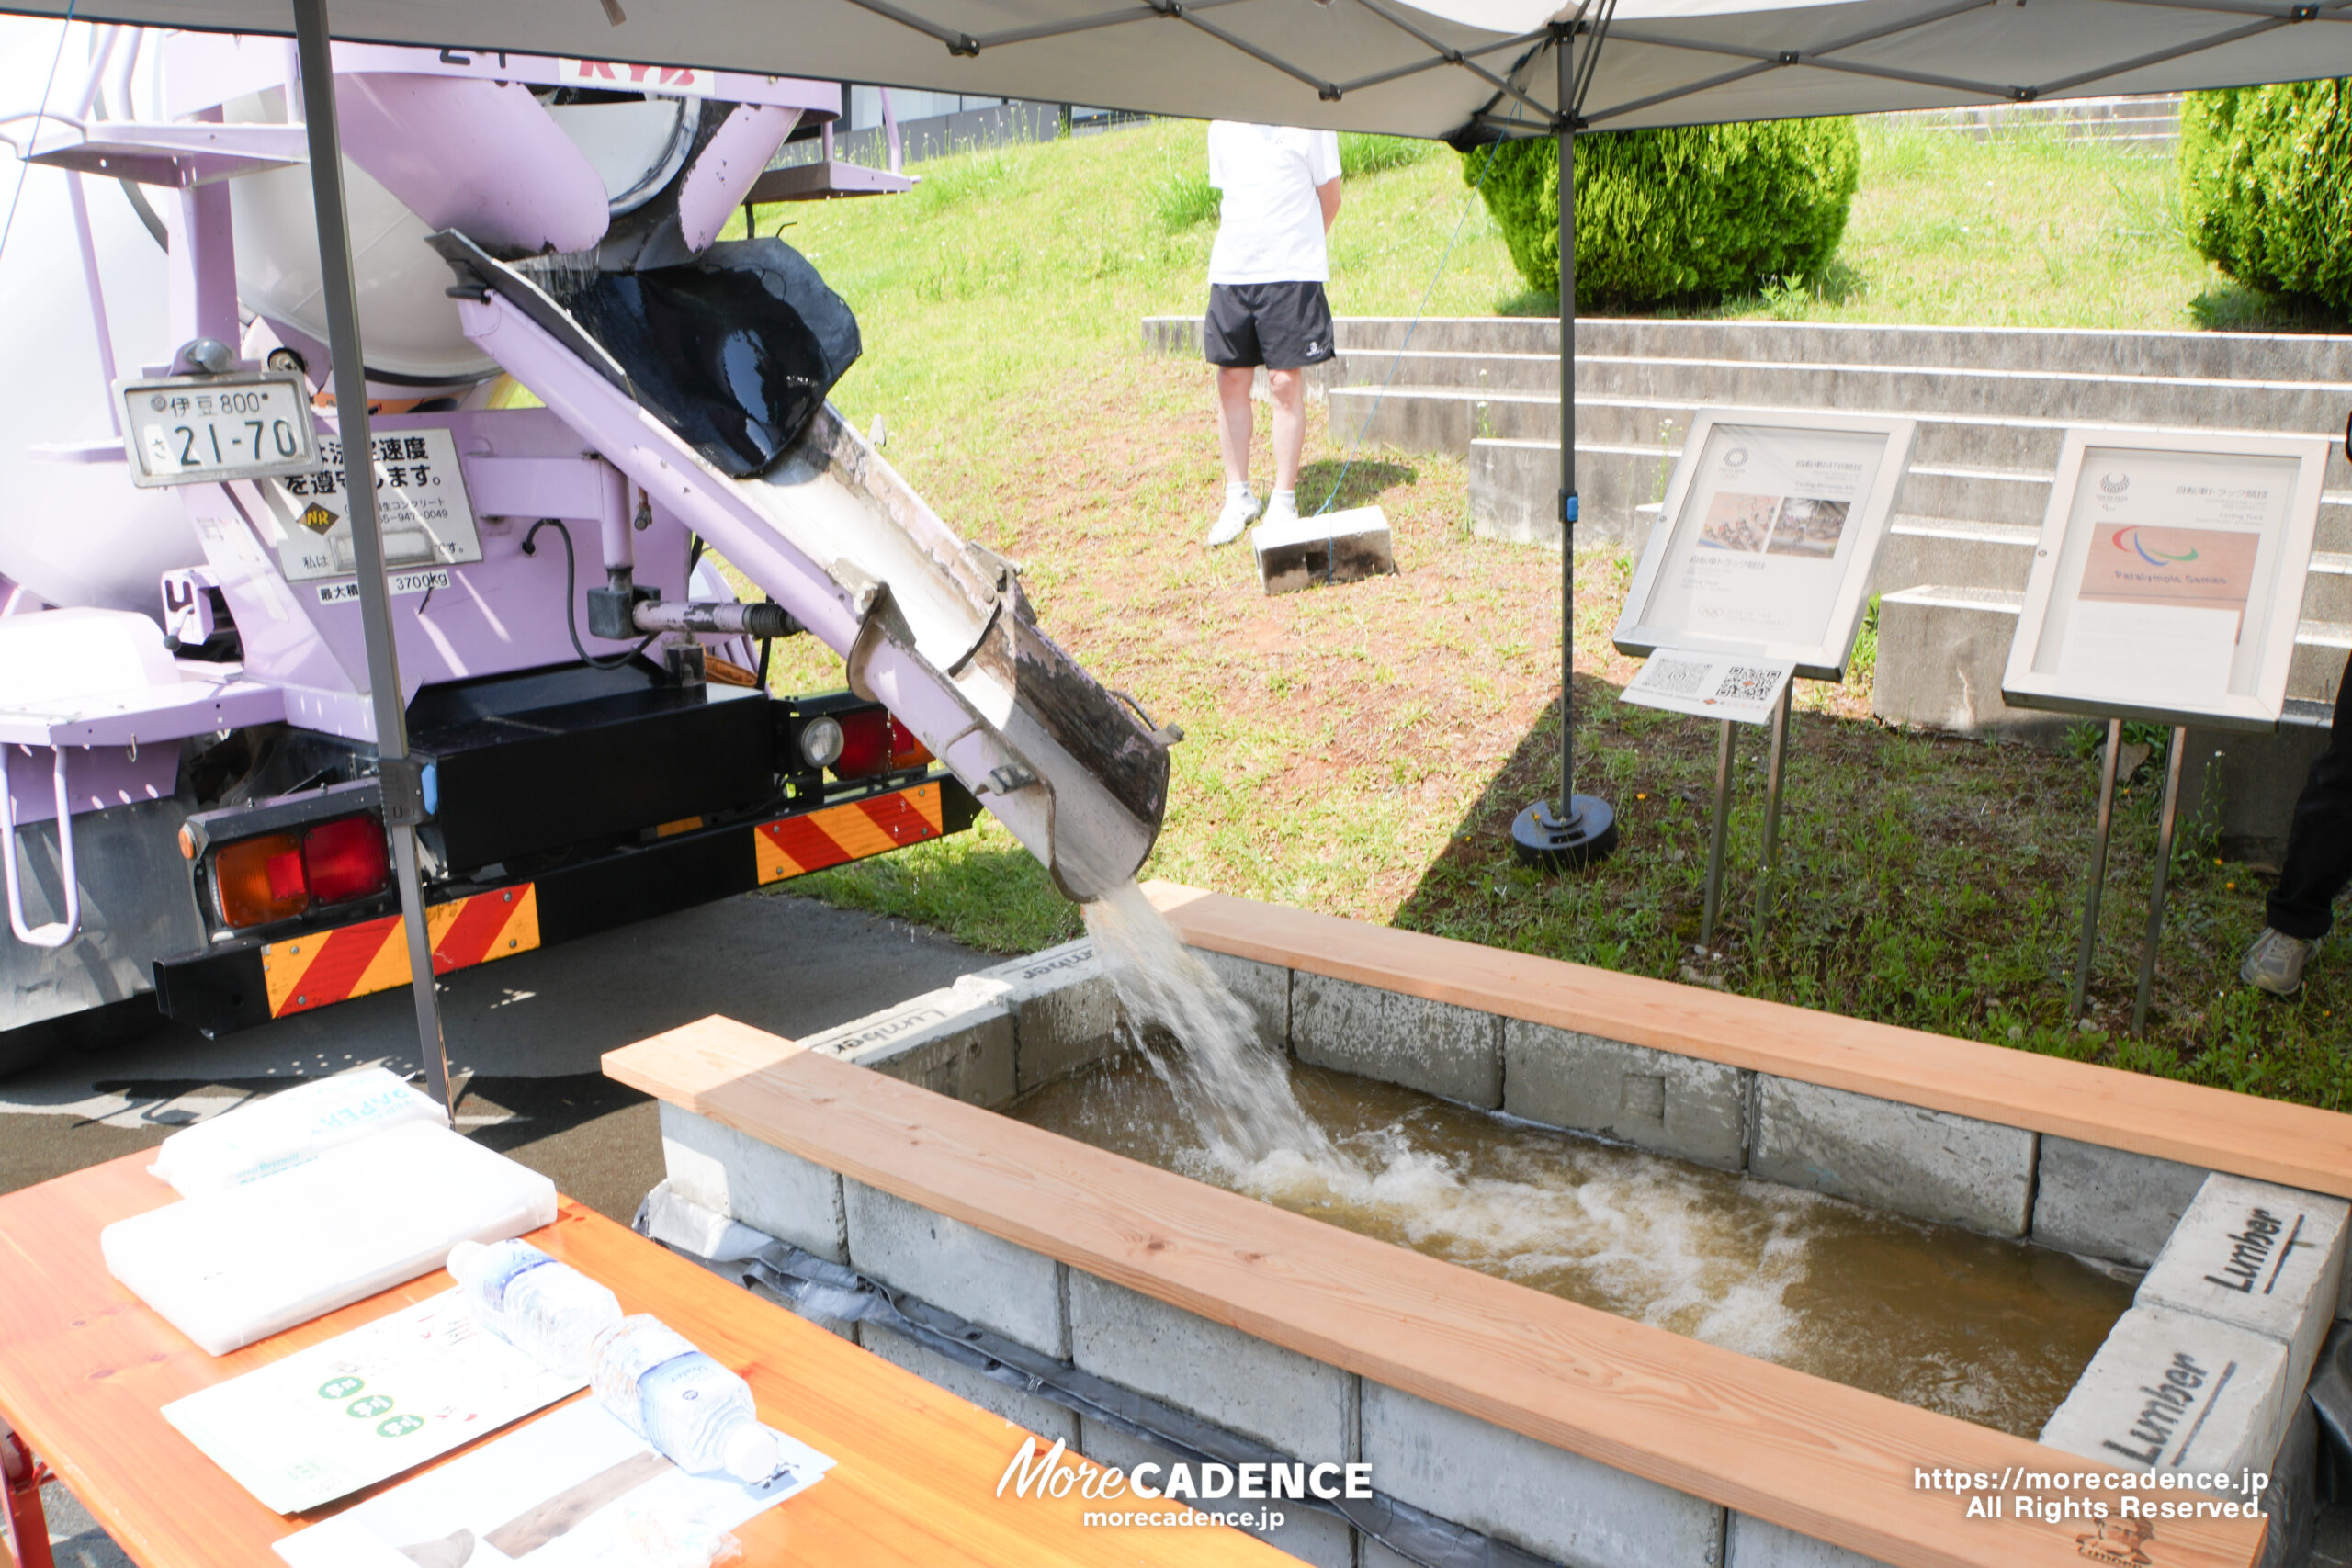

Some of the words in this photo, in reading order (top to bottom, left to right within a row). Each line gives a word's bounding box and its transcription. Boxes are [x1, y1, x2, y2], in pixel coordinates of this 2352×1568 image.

[220, 392, 260, 414] 800
[175, 419, 297, 466] 21-70
[2114, 570, 2182, 585] Paralympic
[2184, 573, 2228, 586] Games
[2203, 1207, 2283, 1294] Lumber
[2101, 1352, 2208, 1467] Lumber
